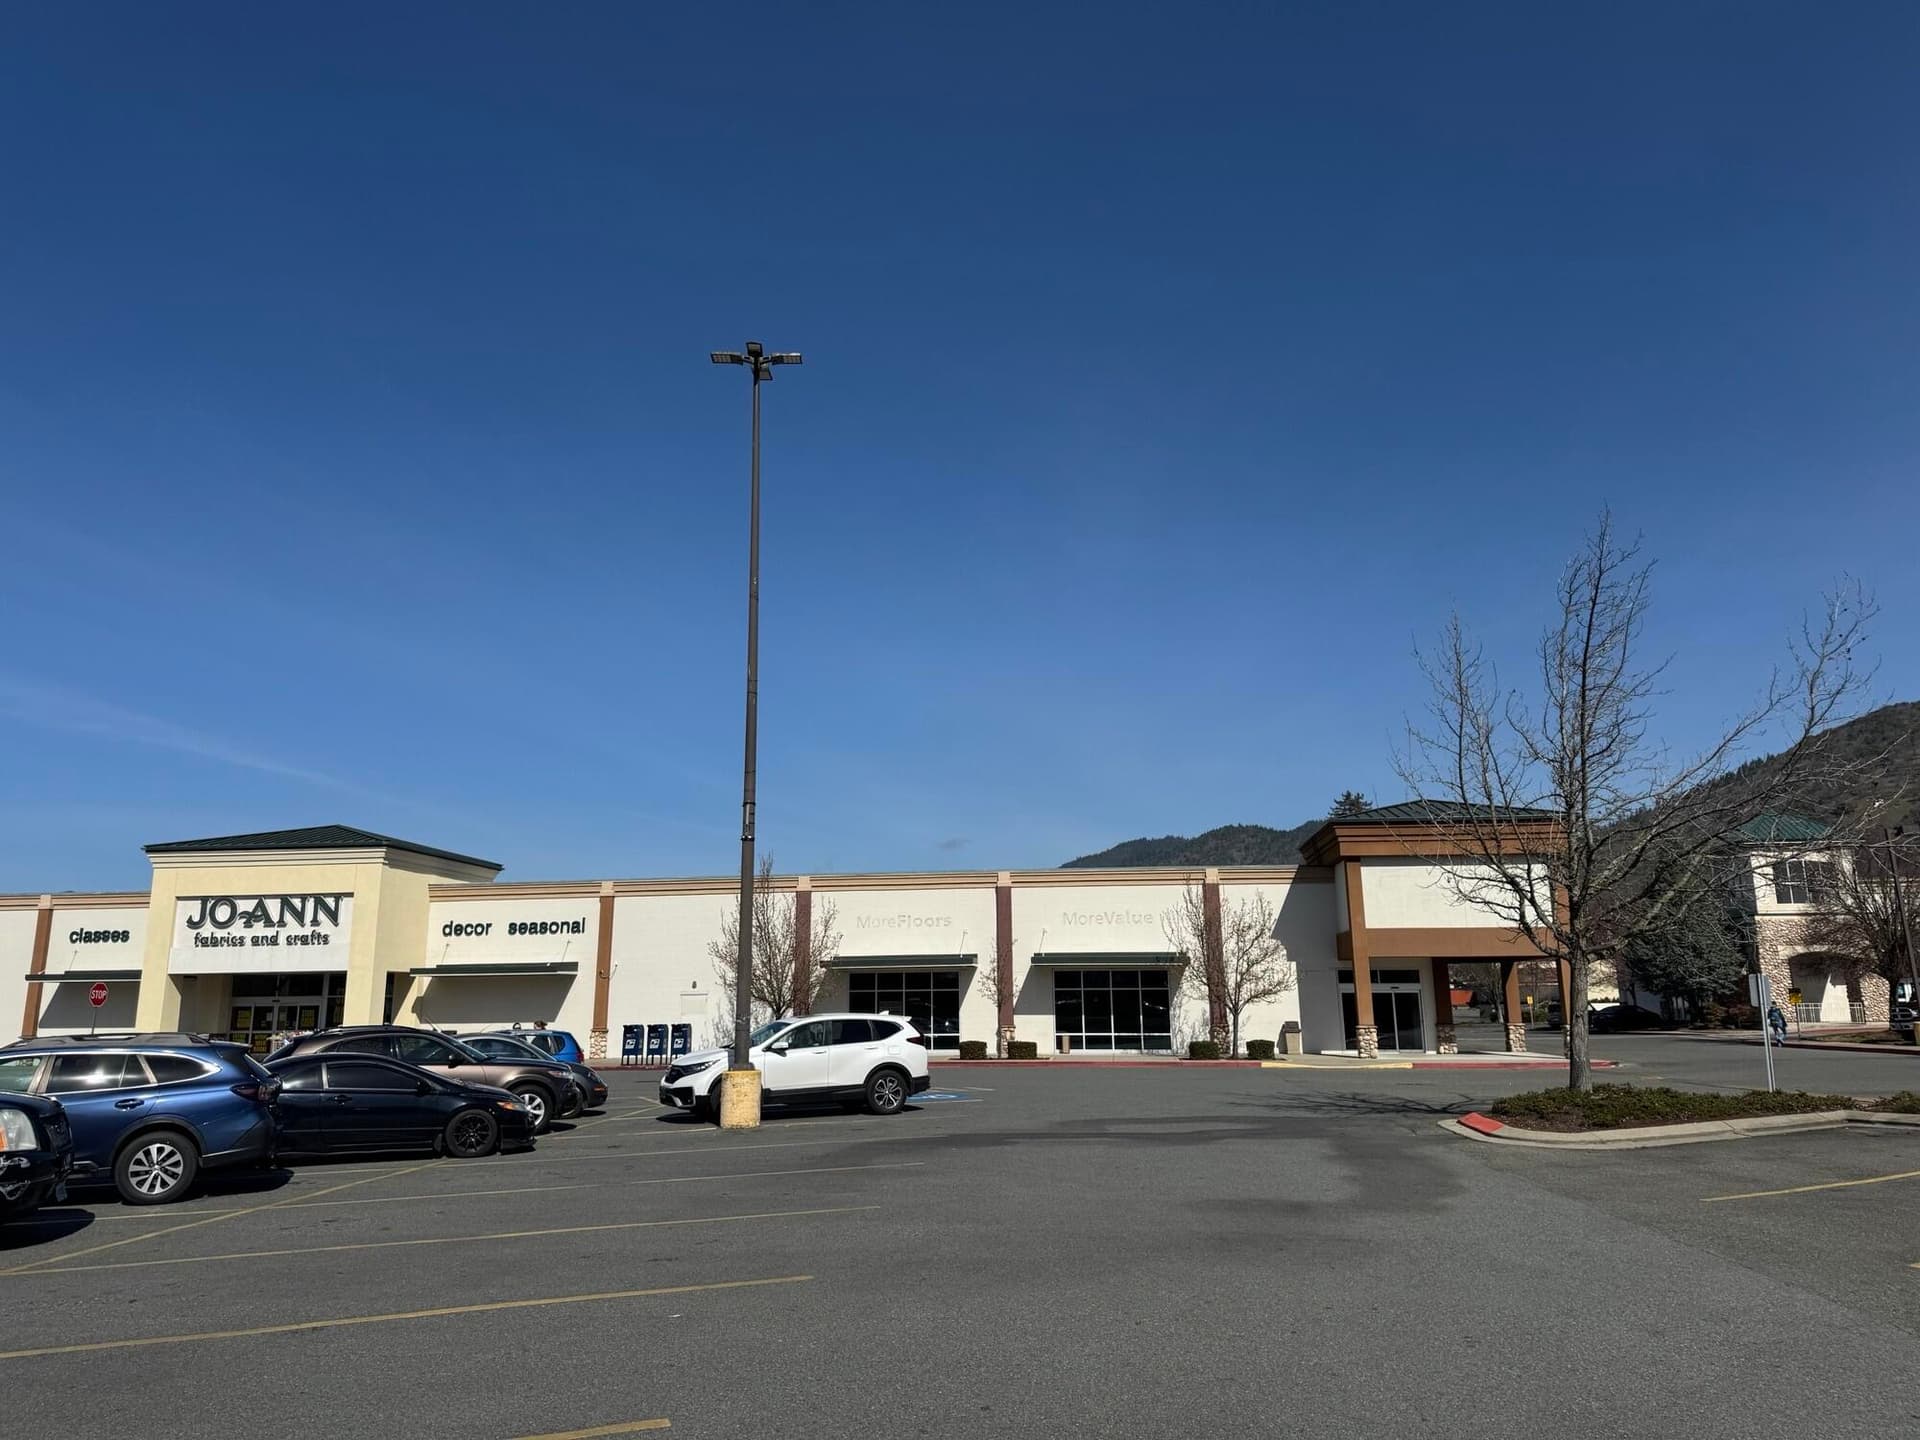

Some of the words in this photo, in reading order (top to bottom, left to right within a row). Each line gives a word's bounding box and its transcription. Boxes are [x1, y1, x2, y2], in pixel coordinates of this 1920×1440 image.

[442, 919, 492, 937] decor
[508, 916, 586, 935] seasonal
[856, 914, 952, 929] MoreFloors
[1062, 909, 1153, 927] MoreValue
[69, 927, 130, 944] classes
[193, 931, 246, 948] fabrics
[250, 930, 280, 946] and
[285, 929, 331, 946] crafts
[91, 989, 107, 1000] STOP
